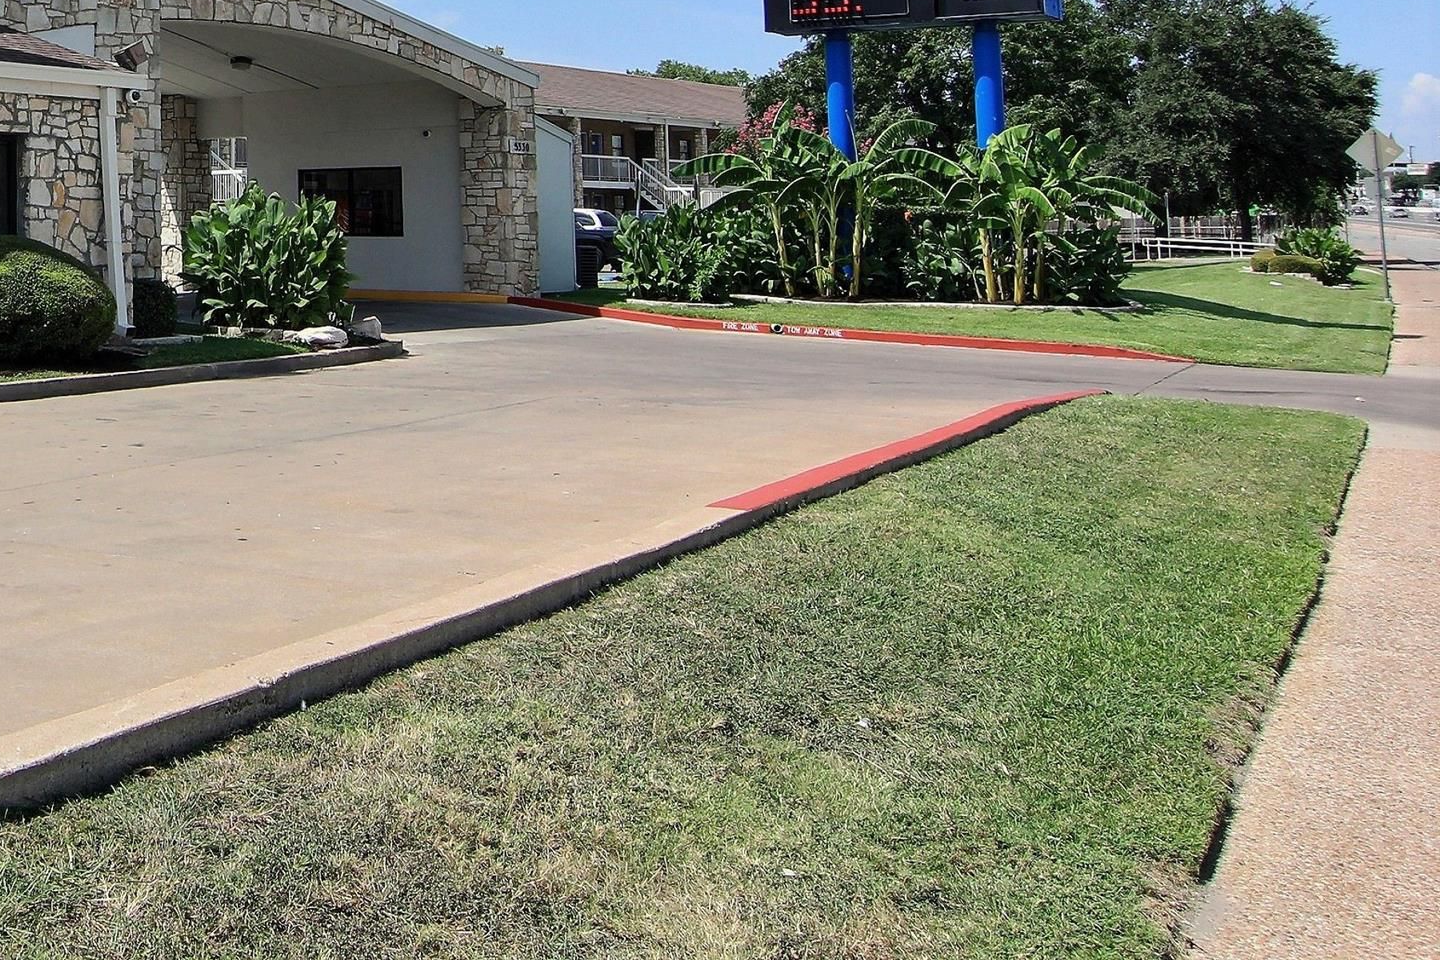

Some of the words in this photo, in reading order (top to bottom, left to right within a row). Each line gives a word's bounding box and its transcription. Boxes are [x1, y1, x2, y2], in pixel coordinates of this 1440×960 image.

[722, 321, 739, 330] FIRE
[740, 322, 759, 332] ZONE
[786, 325, 801, 334] TOW
[803, 326, 821, 336] AWAY
[823, 328, 843, 337] ZONE
